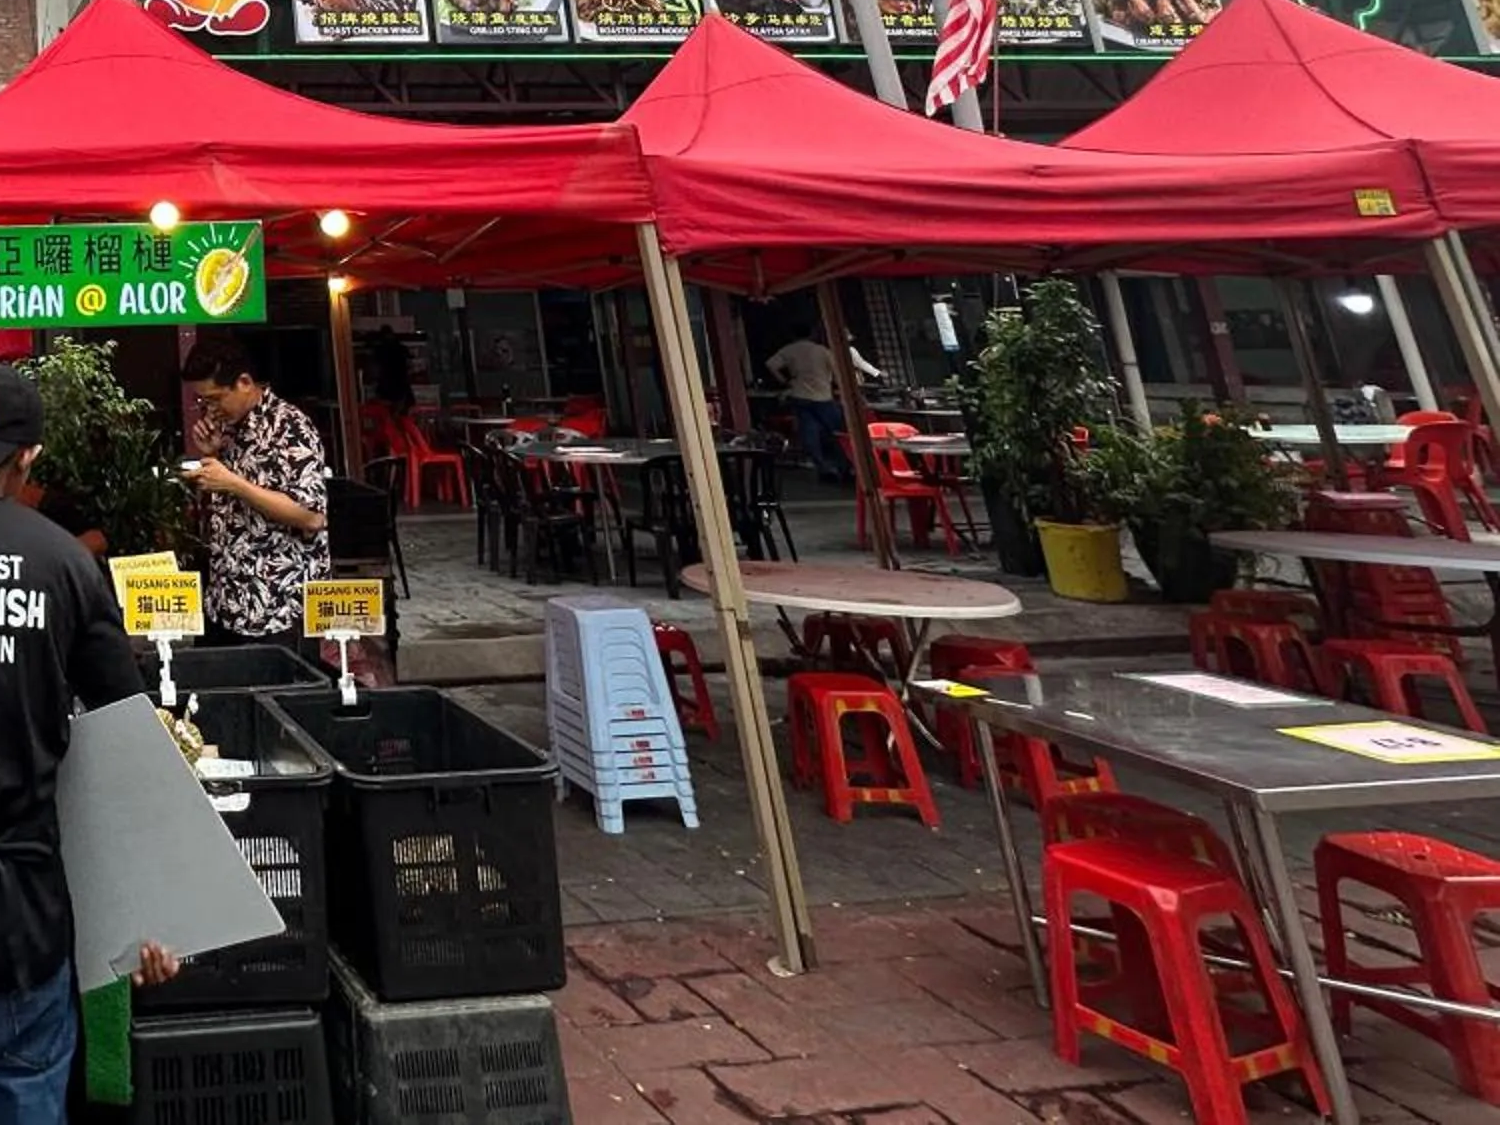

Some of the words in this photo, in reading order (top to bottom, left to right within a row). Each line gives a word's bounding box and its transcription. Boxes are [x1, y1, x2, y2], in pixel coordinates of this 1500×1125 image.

[745, 26, 785, 35] ALAYSIA
[75, 283, 107, 316] @
[118, 280, 187, 315] ALOR
[126, 578, 170, 590] MUSANG
[171, 578, 197, 589] KING
[307, 586, 352, 596] MUSANG
[353, 586, 379, 595] KING
[137, 595, 189, 614] 猫山王
[317, 600, 370, 618] 猫山王
